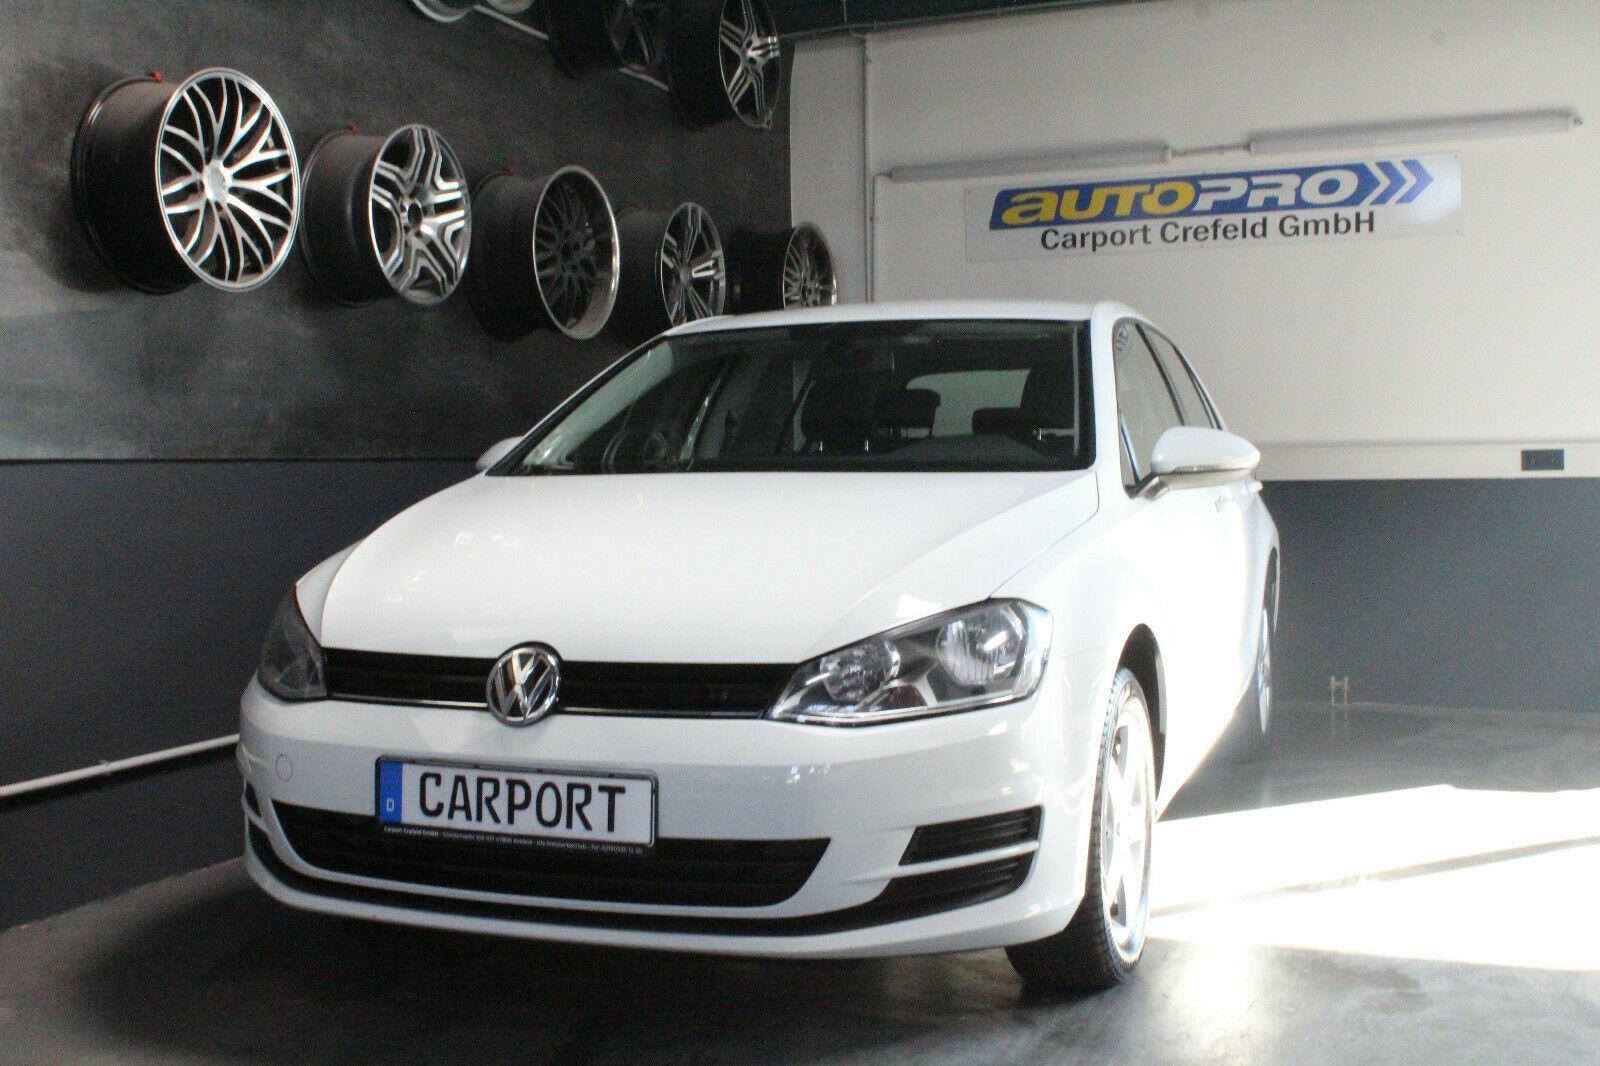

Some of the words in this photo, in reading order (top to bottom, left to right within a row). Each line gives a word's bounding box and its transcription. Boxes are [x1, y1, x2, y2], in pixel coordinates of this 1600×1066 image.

[1042, 224, 1151, 251] Carport
[1161, 216, 1267, 244] Crefeld
[1279, 210, 1375, 238] GmbH
[386, 799, 395, 813] D
[419, 772, 626, 832] CARPORT
